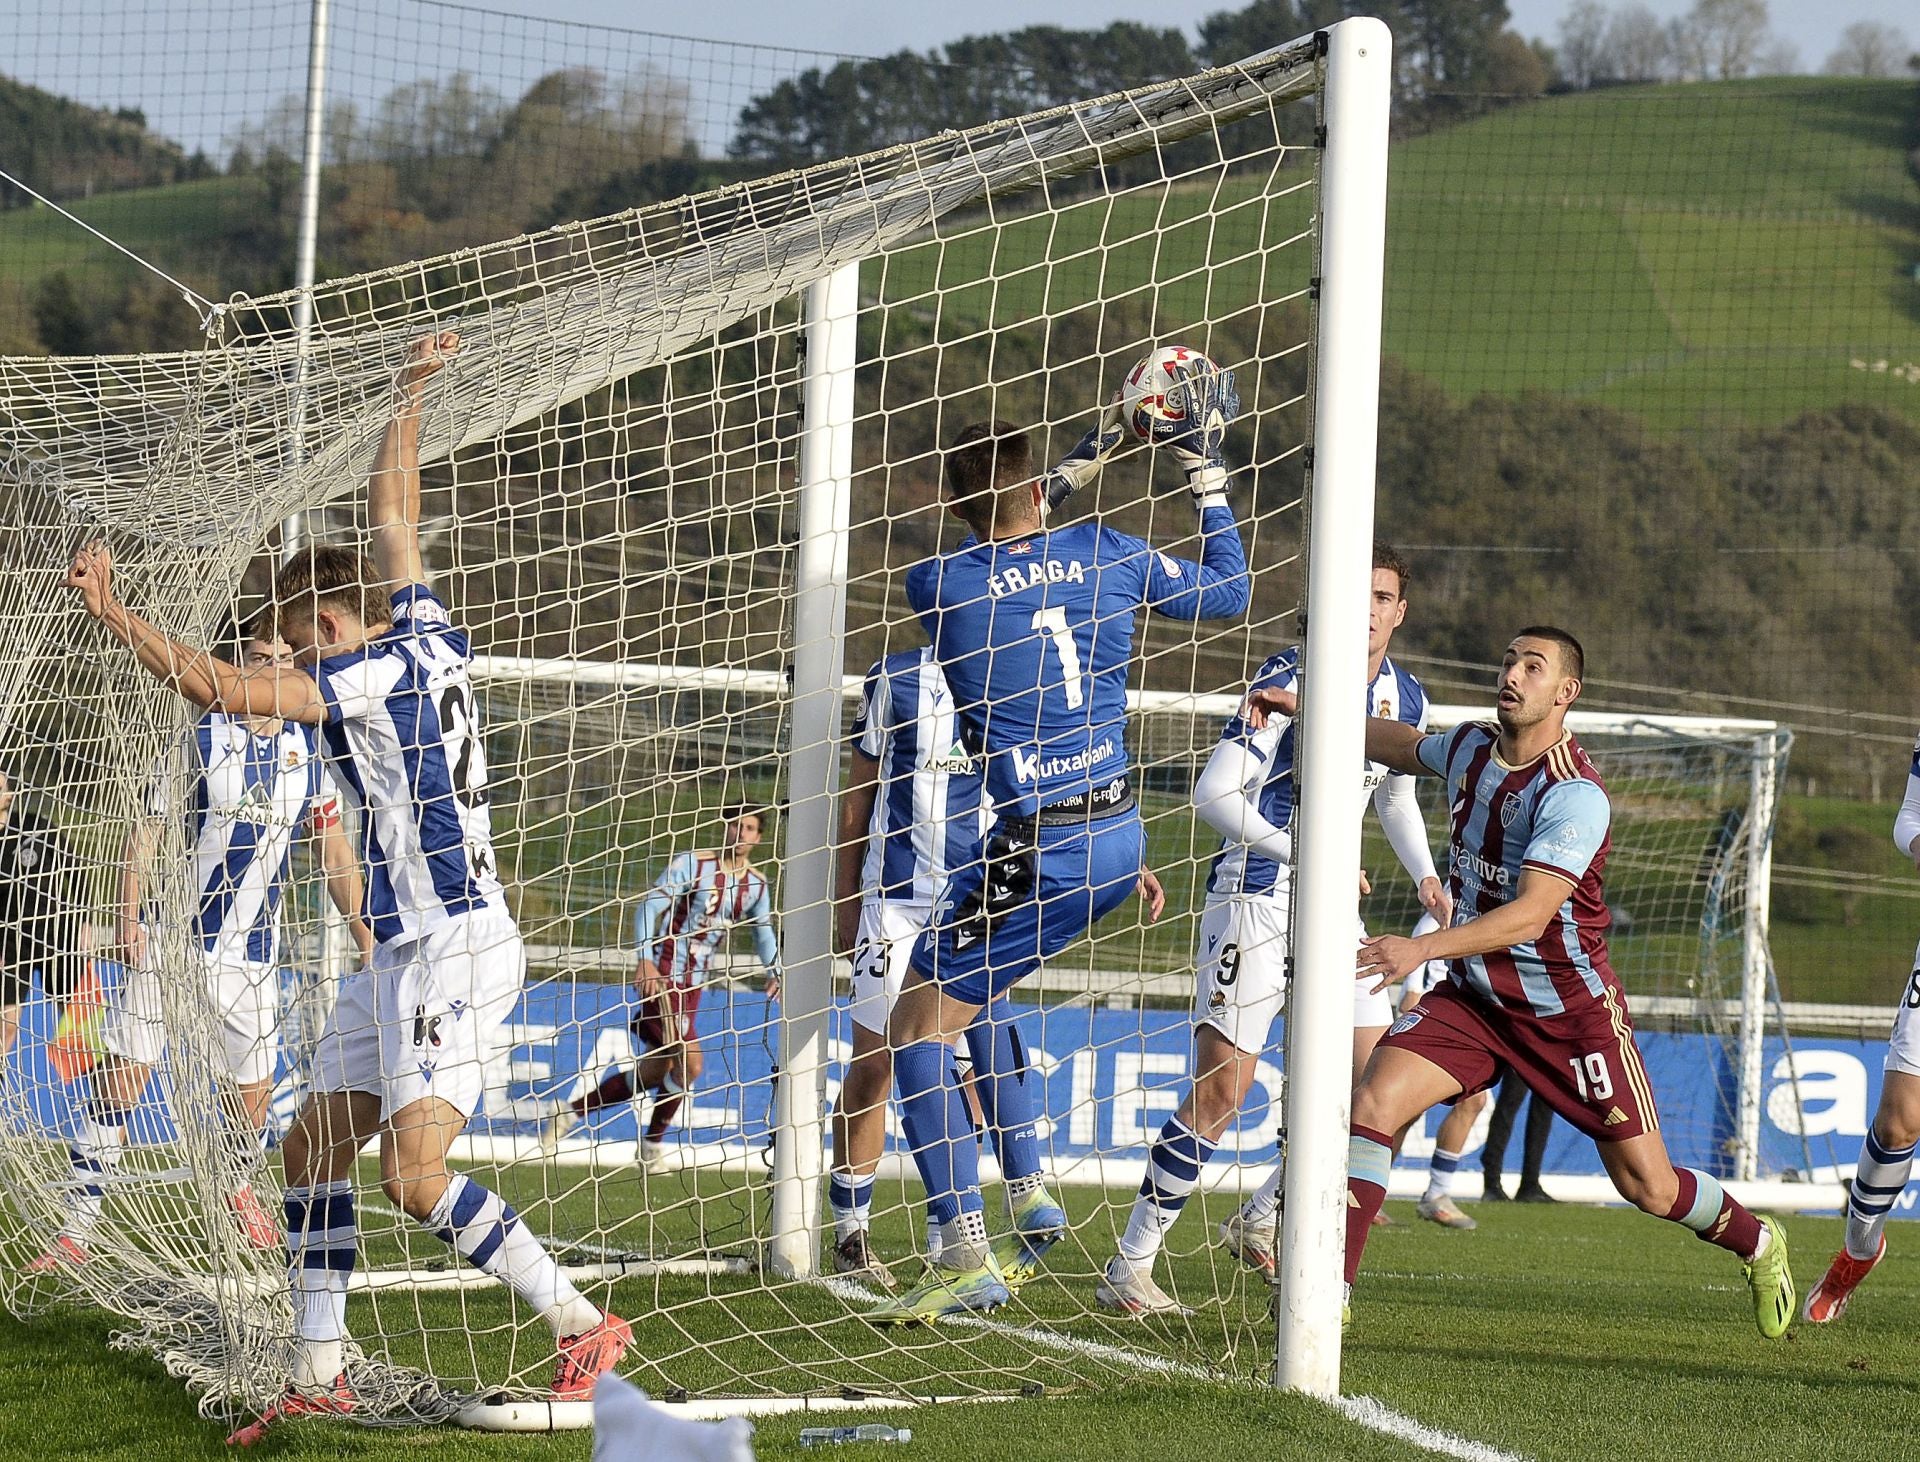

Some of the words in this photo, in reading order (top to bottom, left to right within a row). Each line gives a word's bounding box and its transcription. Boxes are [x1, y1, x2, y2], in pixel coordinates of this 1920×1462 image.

[986, 560, 1085, 597] FRAGA
[1031, 605, 1084, 711] 1
[853, 937, 894, 978] 23
[1216, 943, 1241, 986] 9
[1569, 1052, 1614, 1102] 19
